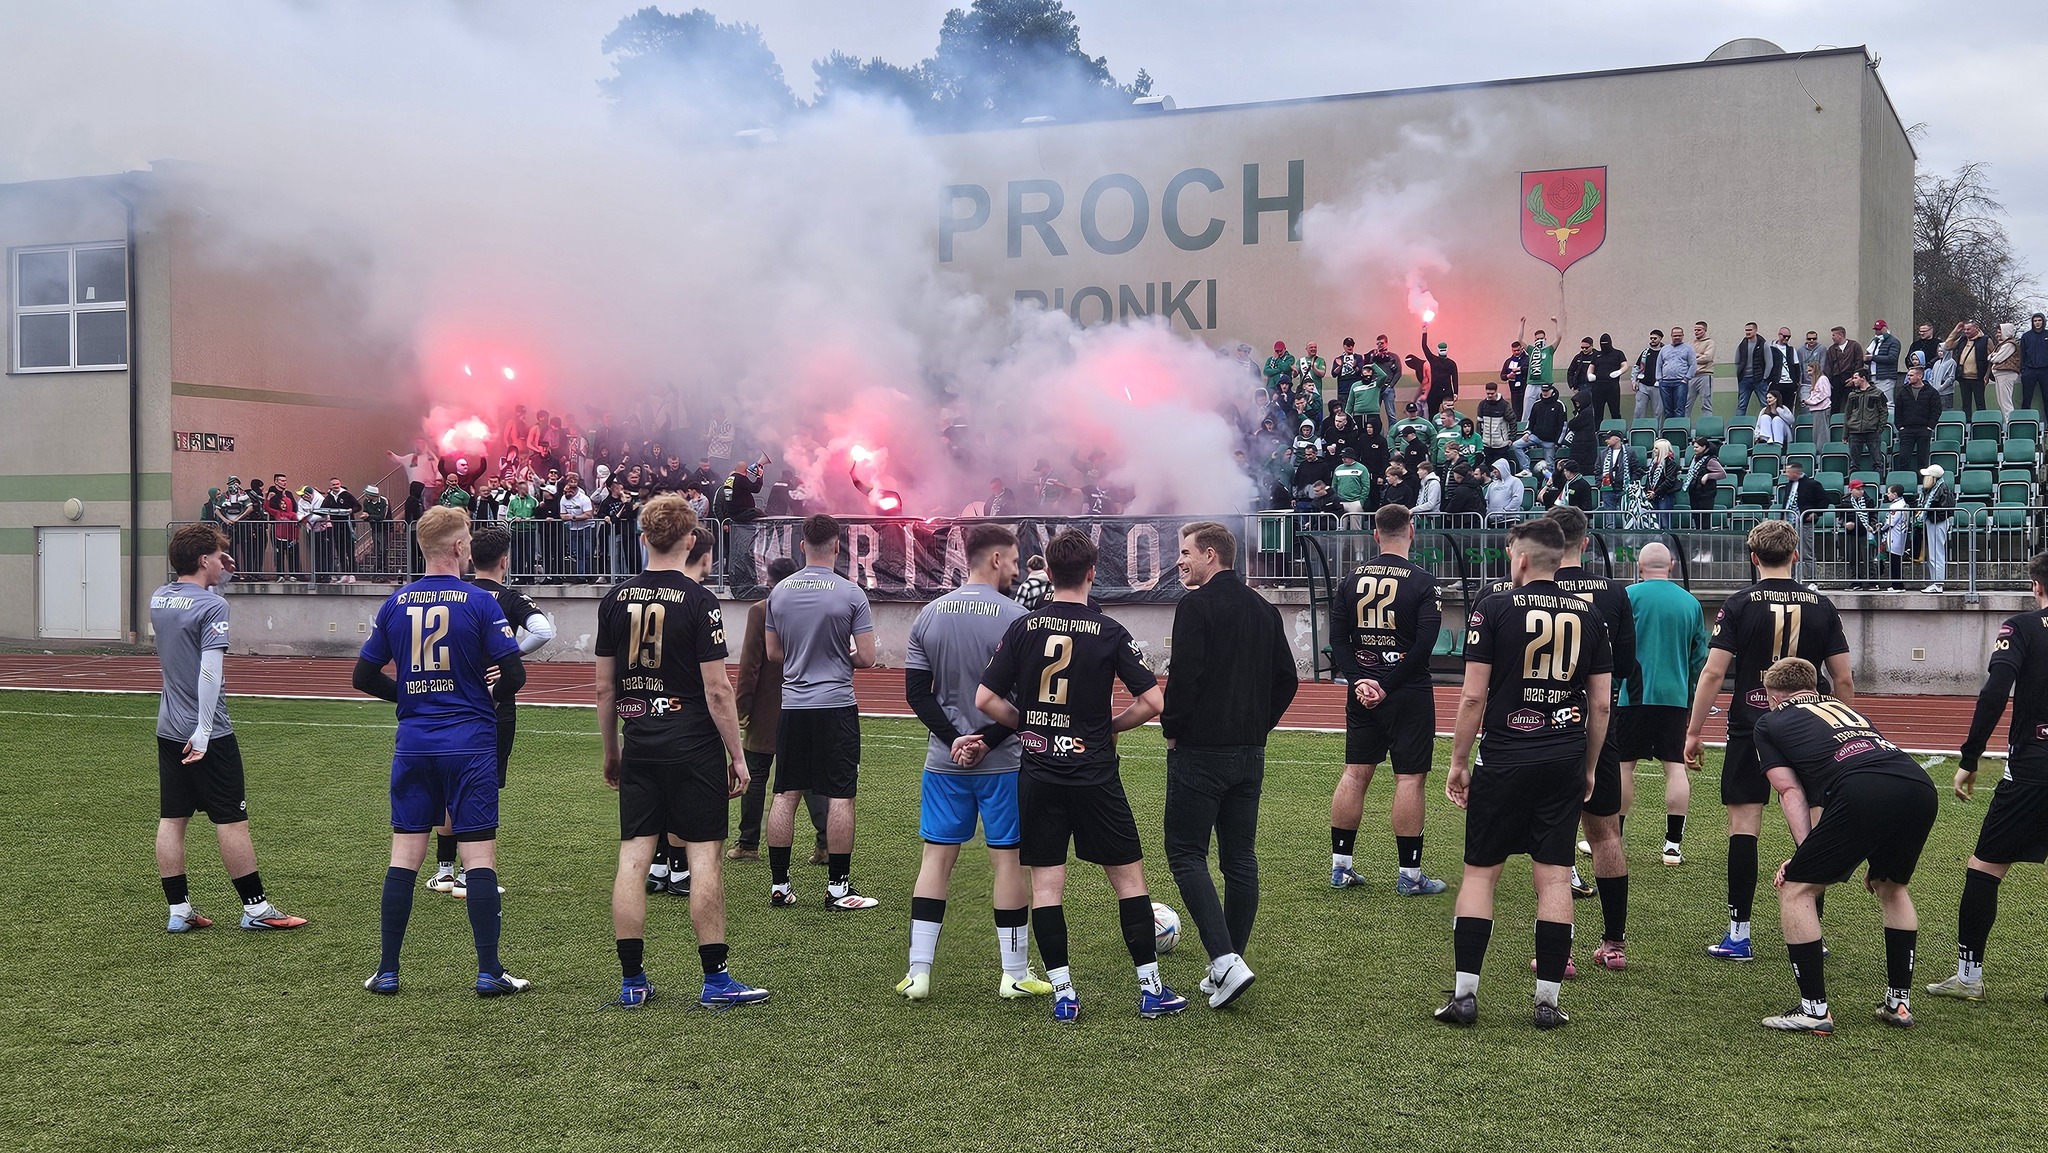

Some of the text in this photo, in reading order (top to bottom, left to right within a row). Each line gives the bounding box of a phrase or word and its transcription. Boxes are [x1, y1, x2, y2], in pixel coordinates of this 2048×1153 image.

[938, 159, 1304, 263] PROCH
[1364, 565, 1387, 576] PROCH
[1386, 566, 1411, 578] PIONKI
[783, 579, 836, 591] PROCH PIONKI
[1578, 580, 1608, 591] PIONKI
[408, 591, 437, 604] PROCH
[438, 590, 468, 604] PIONKI
[655, 587, 686, 603] PIONKI
[1356, 576, 1399, 630] 22
[1513, 594, 1526, 606] KS
[1528, 594, 1558, 609] PROCH
[1560, 597, 1589, 612] PIONKI
[1750, 590, 1818, 605] KS PROCH PIONKI
[936, 600, 1000, 617] PROCH PIONKI
[1026, 616, 1101, 635] KS PROCH PIONKI
[1770, 603, 1801, 662] 11
[406, 605, 451, 673] 12
[627, 603, 666, 670] 19
[1523, 610, 1581, 681] 20
[1038, 634, 1073, 705] 2
[405, 678, 454, 695] 1926-2026
[1511, 713, 1540, 724] elmas
[1795, 701, 1871, 729] 10
[1053, 735, 1085, 753] KPS
